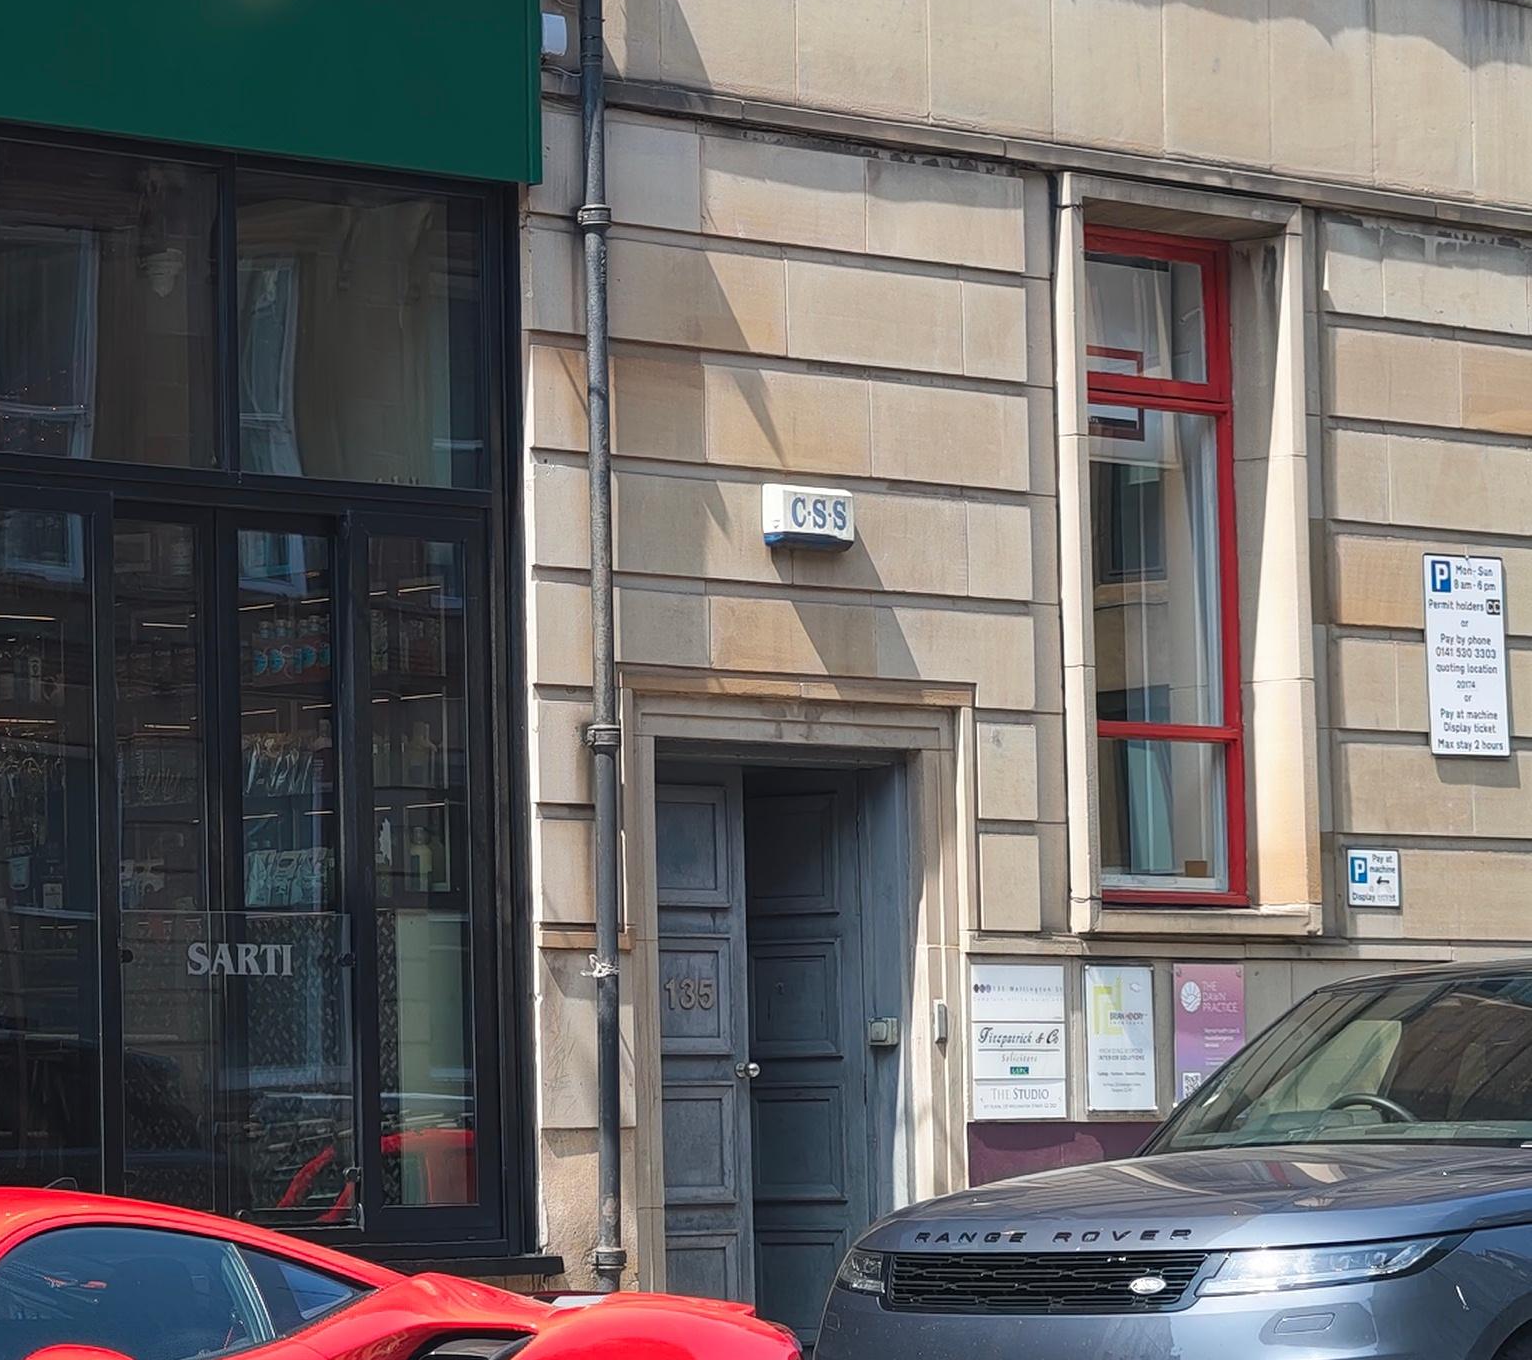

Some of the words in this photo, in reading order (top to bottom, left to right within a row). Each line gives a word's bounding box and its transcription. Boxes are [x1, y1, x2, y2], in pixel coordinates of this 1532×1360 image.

[1428, 598, 1454, 610] Permit
[1456, 600, 1484, 612] holders
[1460, 620, 1469, 628] or
[1440, 633, 1454, 645] Pay
[1456, 634, 1466, 646] by
[1467, 636, 1492, 646] phone
[1435, 646, 1454, 657] 0141
[1456, 647, 1472, 658] 530
[1474, 648, 1497, 659] 3303
[1435, 663, 1465, 675] quoting
[1467, 663, 1498, 674] location
[1464, 694, 1472, 702] or
[1440, 708, 1454, 720] Pay
[1456, 710, 1465, 719] at
[1466, 710, 1498, 720] machine
[1443, 722, 1472, 735] Display
[1474, 723, 1497, 734] ticket
[1437, 738, 1454, 749] Max
[1456, 739, 1472, 751] stay
[1474, 739, 1480, 750] 2
[1482, 740, 1503, 750] hours
[1352, 891, 1376, 903] Display
[187, 942, 293, 976] SARTI
[663, 976, 714, 1010] 135
[990, 1087, 1011, 1100] THE
[1013, 1087, 1050, 1100] STUDIO
[914, 1231, 1027, 1244] RANGE
[1052, 1229, 1192, 1244] ROVER
